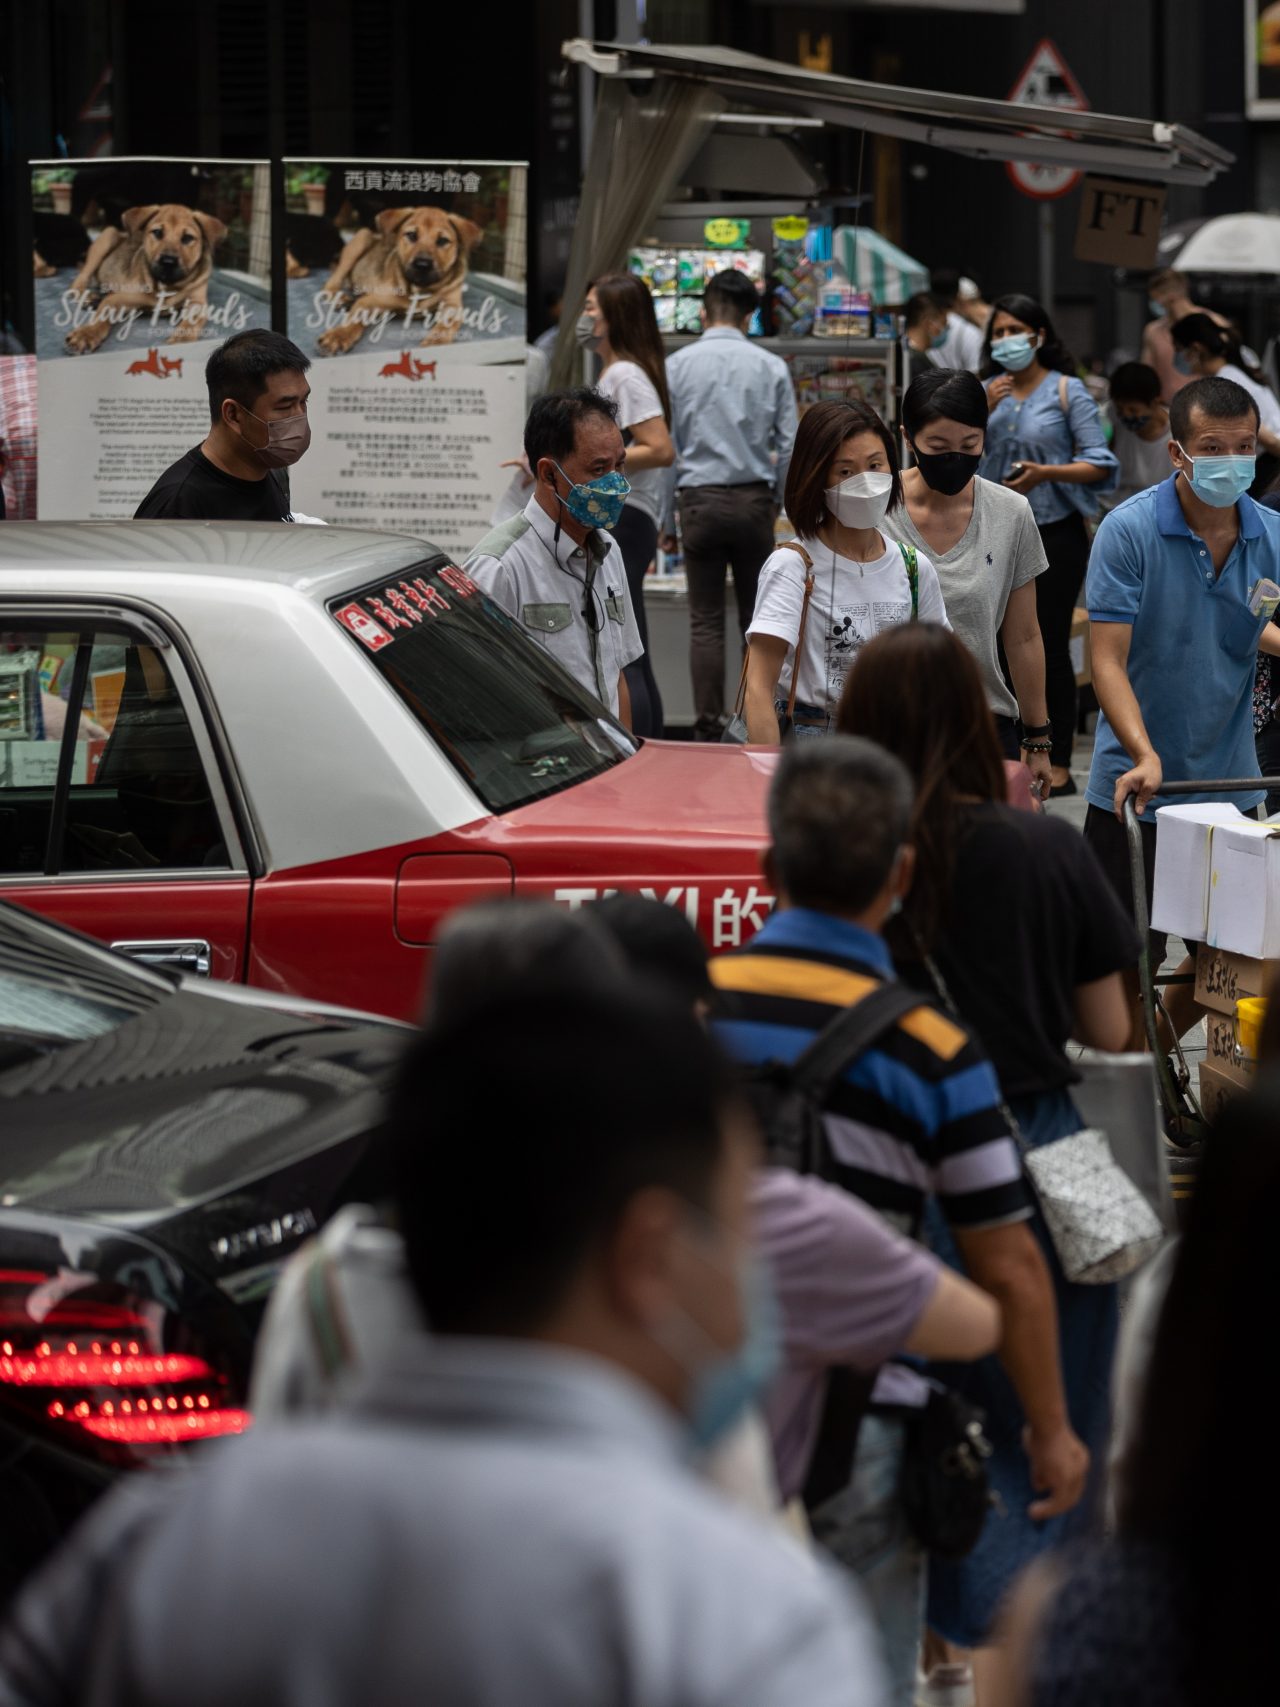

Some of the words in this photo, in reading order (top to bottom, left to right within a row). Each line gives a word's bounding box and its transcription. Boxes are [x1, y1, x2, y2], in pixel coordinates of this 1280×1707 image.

[344, 169, 482, 193] 西貢流浪狗協會
[1088, 187, 1159, 236] FT
[53, 288, 144, 341] Stray
[150, 290, 253, 330] Friends
[305, 290, 397, 343] Stray
[402, 293, 508, 333] Friends
